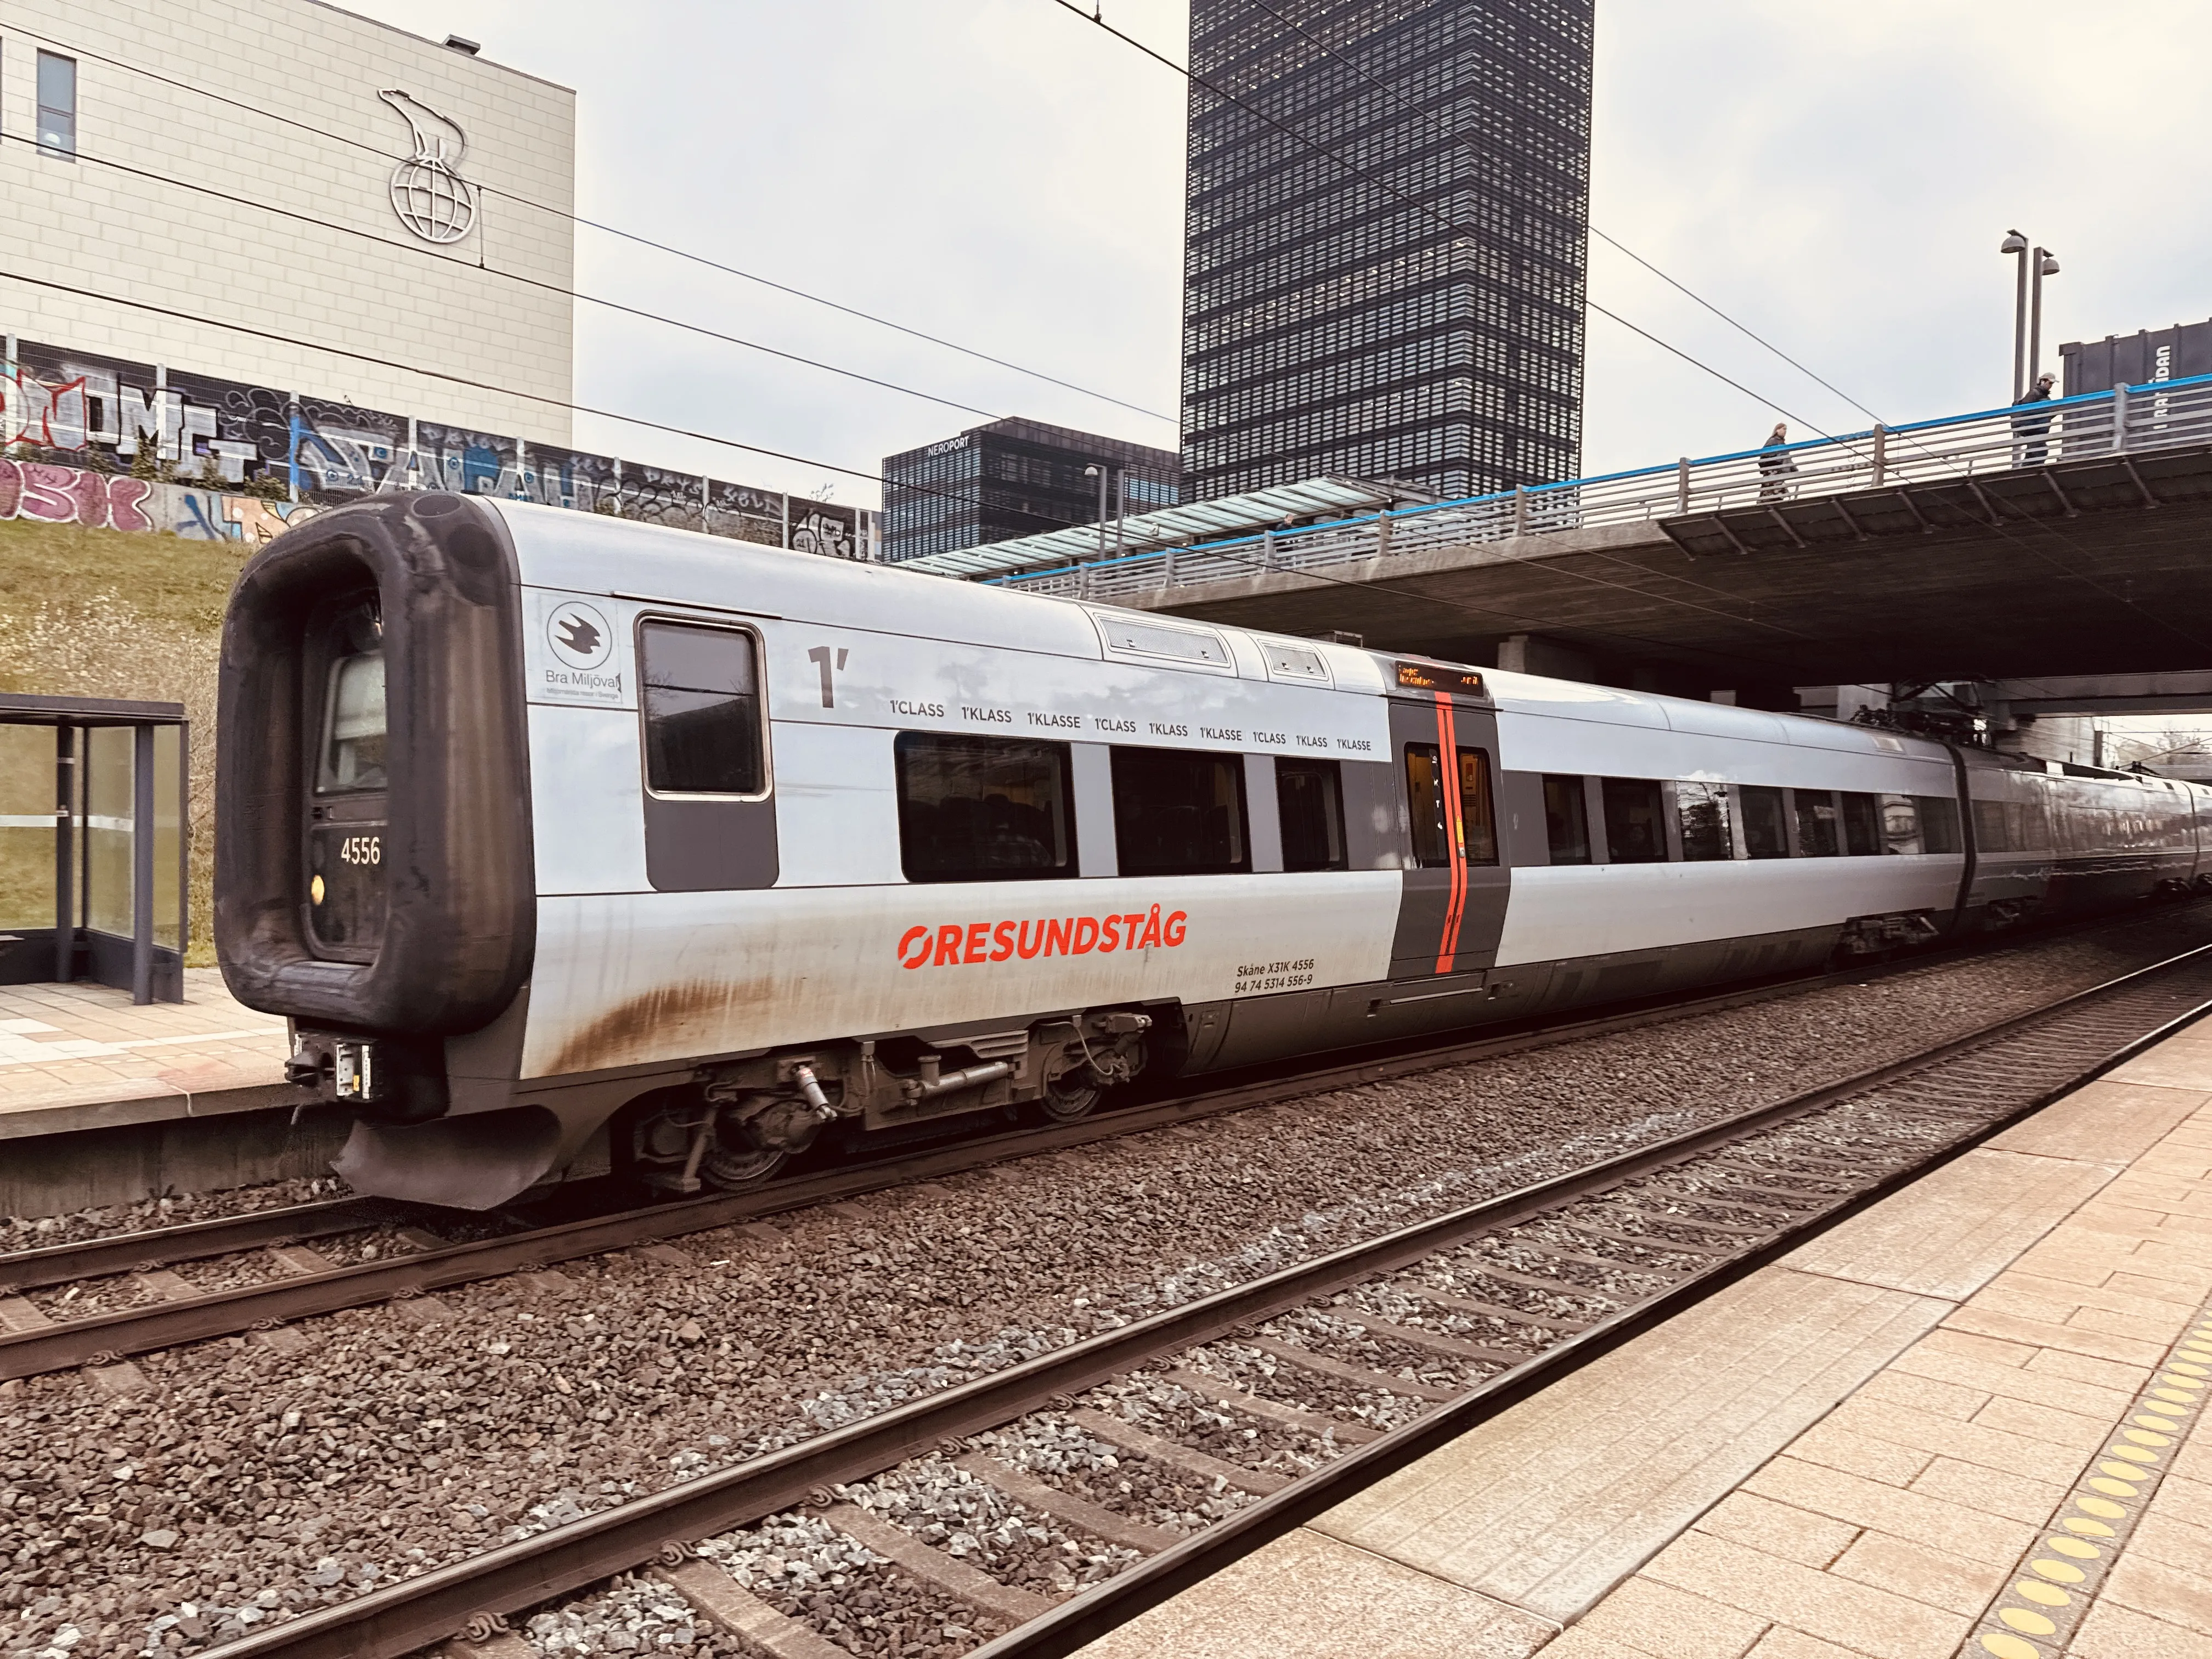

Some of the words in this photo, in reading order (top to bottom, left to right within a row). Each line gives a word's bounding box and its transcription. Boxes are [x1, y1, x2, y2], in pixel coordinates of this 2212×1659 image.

[928, 436, 969, 457] NEROPORT
[546, 670, 568, 684] Bra
[341, 837, 381, 865] 4556
[1236, 963, 1265, 977] Skåne
[1267, 961, 1291, 974] X31K
[1292, 958, 1314, 971] 4556
[1234, 981, 1247, 994] 94
[1250, 979, 1262, 991] 74
[1263, 977, 1285, 990] 5314
[1286, 974, 1313, 987] 556-9
